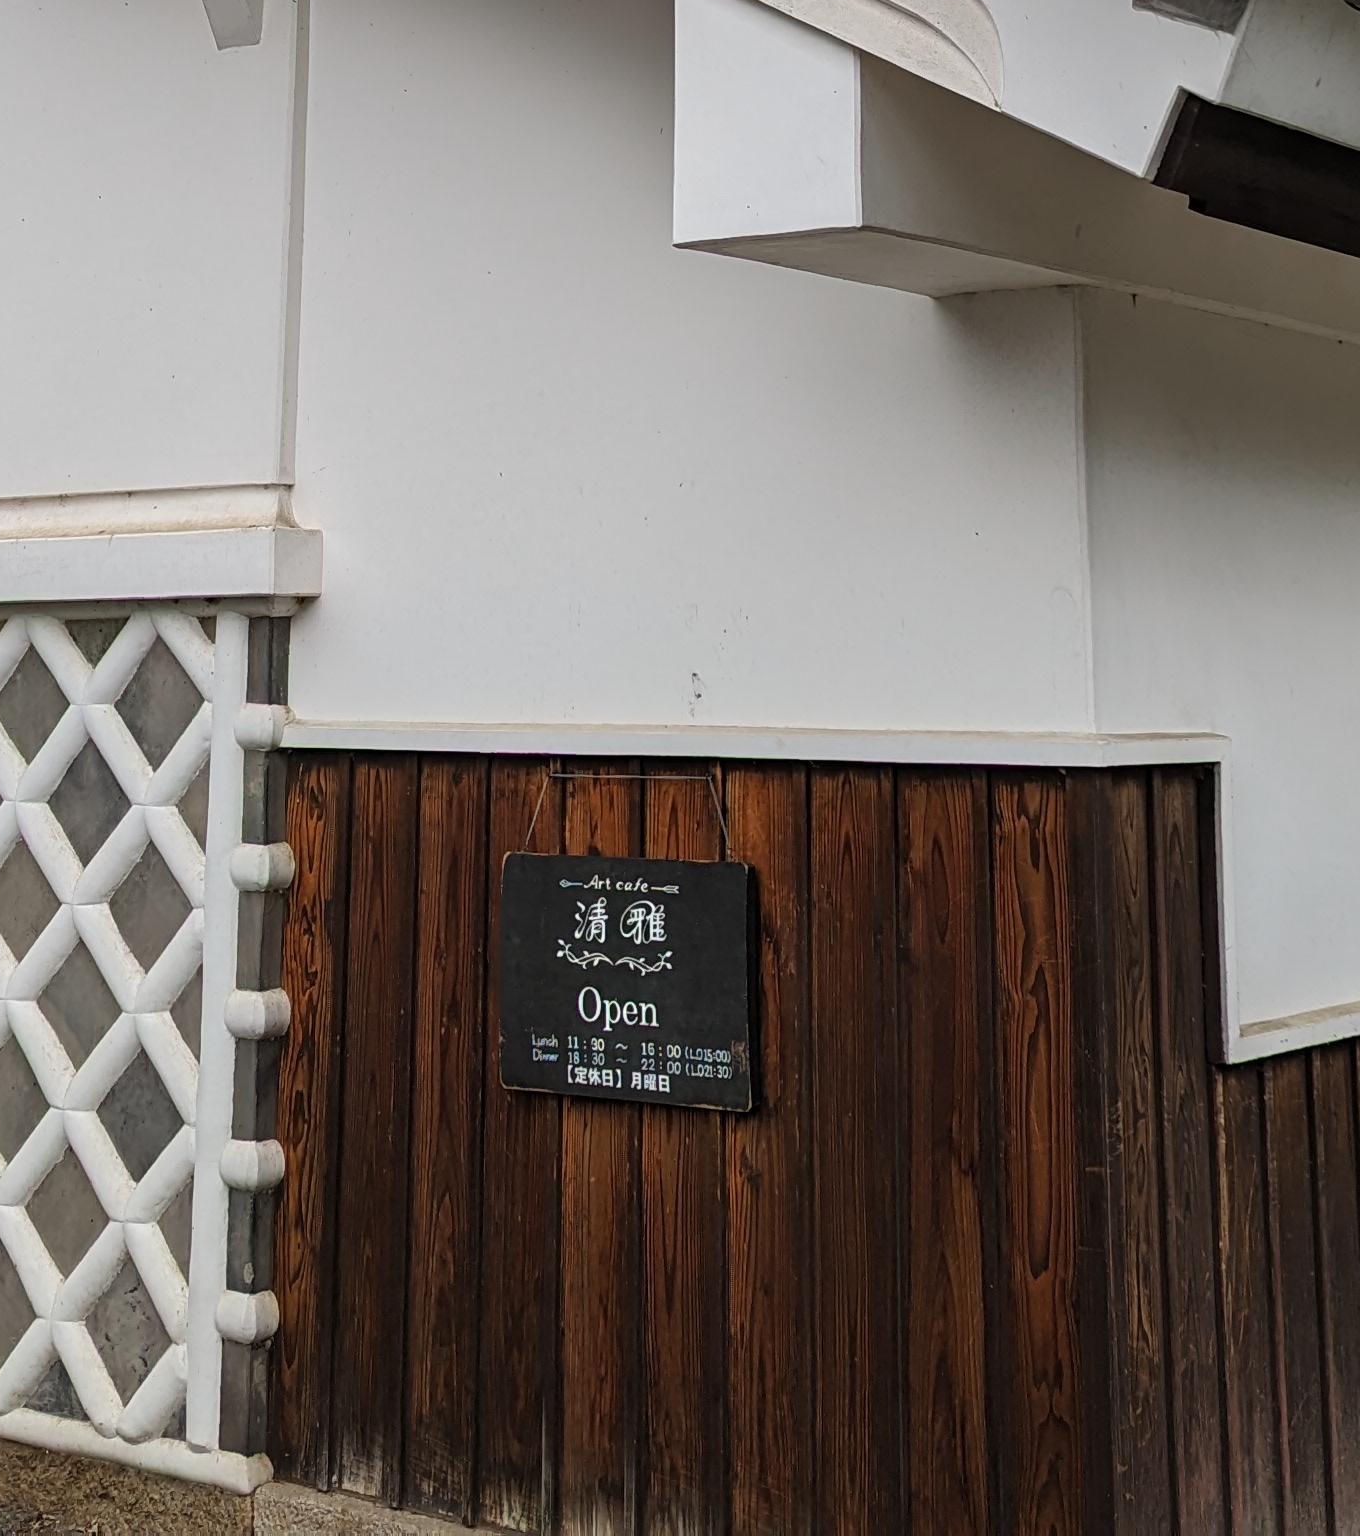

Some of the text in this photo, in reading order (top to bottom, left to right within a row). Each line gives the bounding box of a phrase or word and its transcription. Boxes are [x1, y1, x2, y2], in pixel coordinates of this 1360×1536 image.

[583, 874, 649, 893] Art cafe
[577, 986, 660, 1031] Open
[531, 1033, 559, 1048] Lunch
[533, 1048, 559, 1062] Dinner
[631, 1071, 671, 1093] 月曜日
